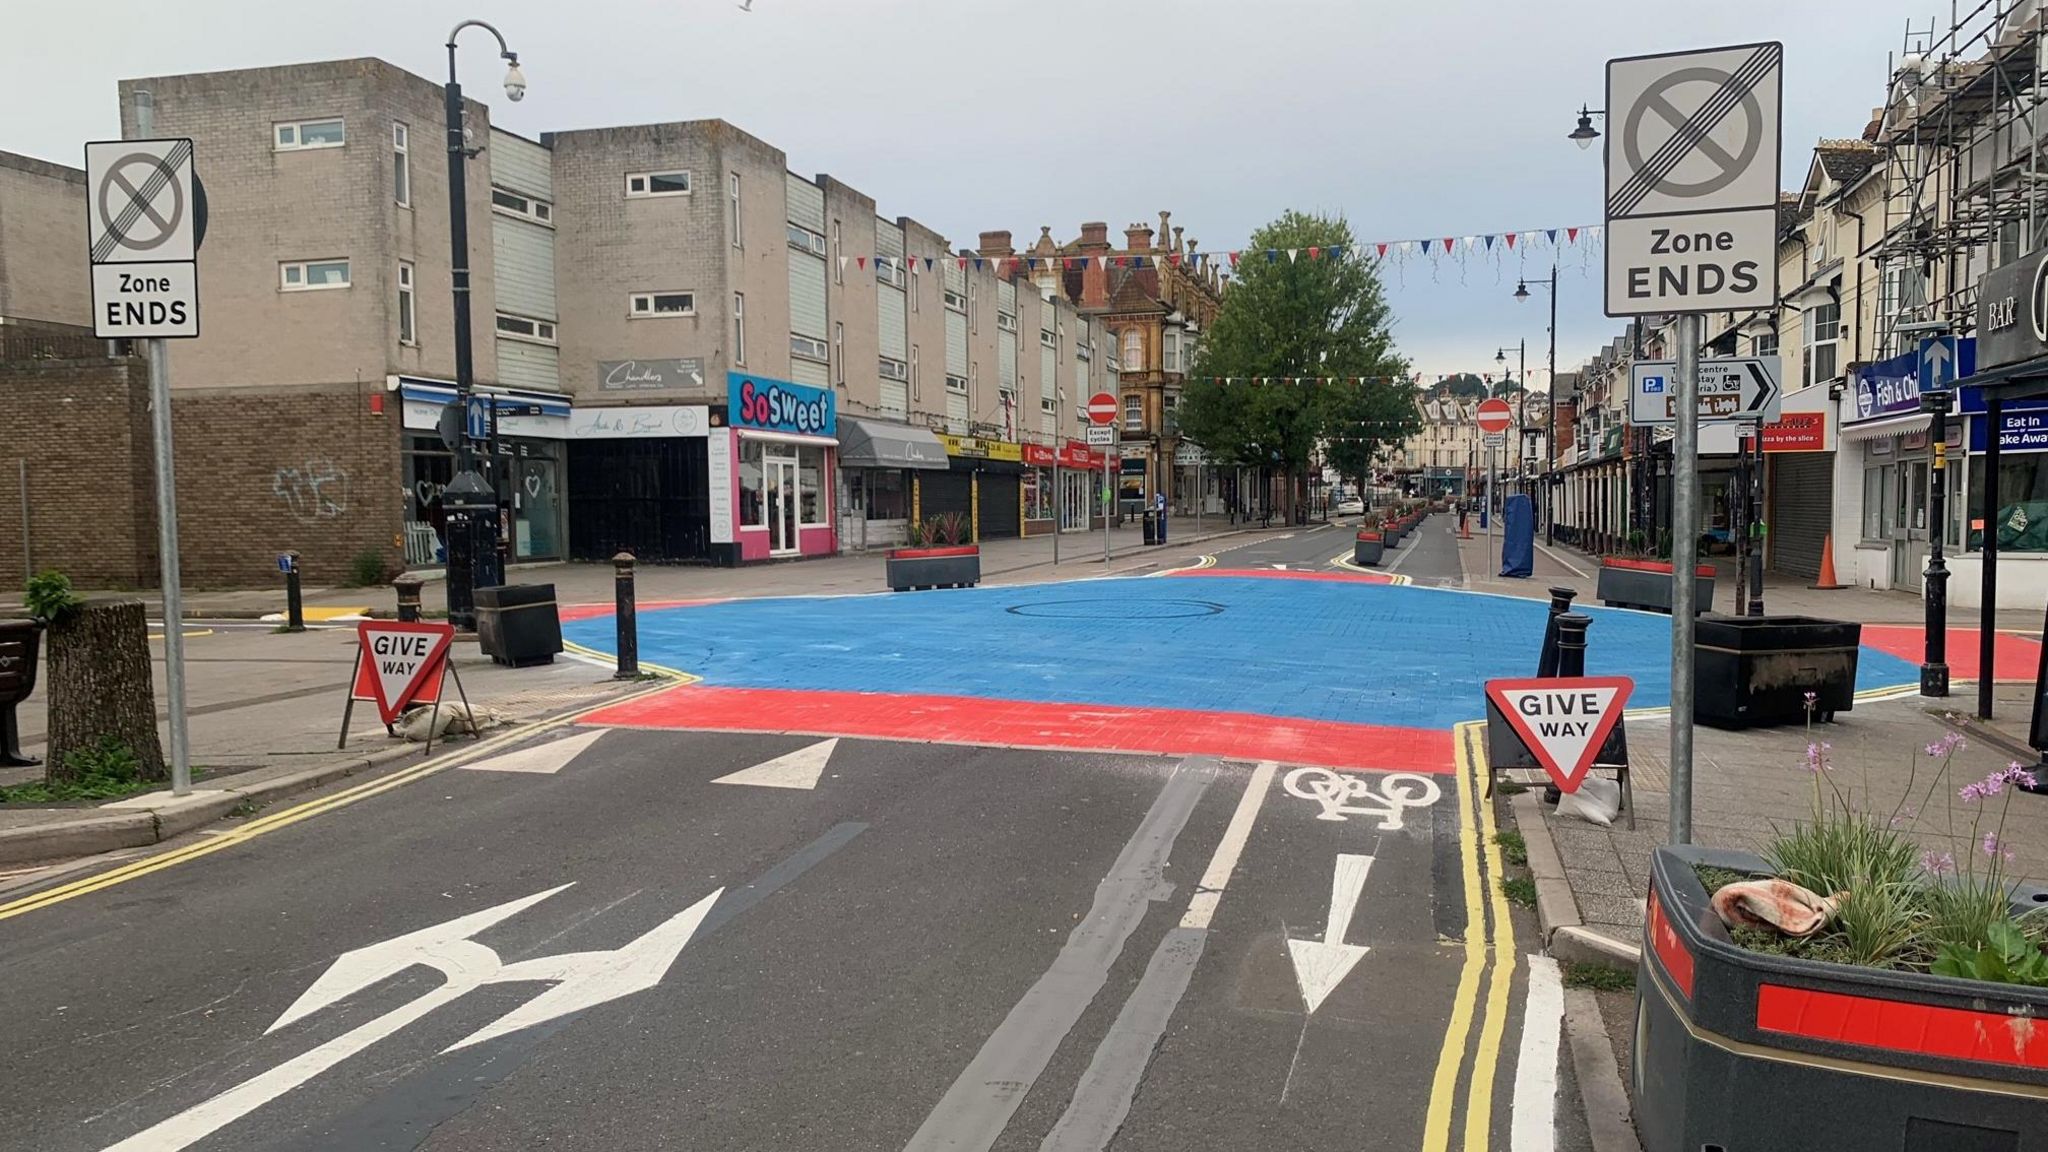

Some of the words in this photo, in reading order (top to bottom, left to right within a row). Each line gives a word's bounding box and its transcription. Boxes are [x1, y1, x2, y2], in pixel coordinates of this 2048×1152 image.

[1651, 228, 1734, 254] Zone
[119, 273, 171, 293] Zone
[1628, 260, 1759, 298] ENDS
[107, 300, 187, 326] ENDS
[1988, 296, 2014, 331] BAR
[1877, 379, 1894, 406] Fish
[1895, 381, 1902, 401] &
[1903, 371, 1918, 401] Chi
[2007, 417, 2026, 428] Eat
[2028, 416, 2040, 426] In
[1089, 429, 1111, 437] Except
[1776, 434, 1784, 443] by
[1798, 434, 1814, 442] slice
[1999, 434, 2020, 445] ake
[2021, 433, 2048, 444] Awa
[374, 636, 428, 656] GIVE
[383, 661, 416, 676] WAY
[1519, 693, 1600, 716] GIVE
[1539, 722, 1589, 737] WAY
